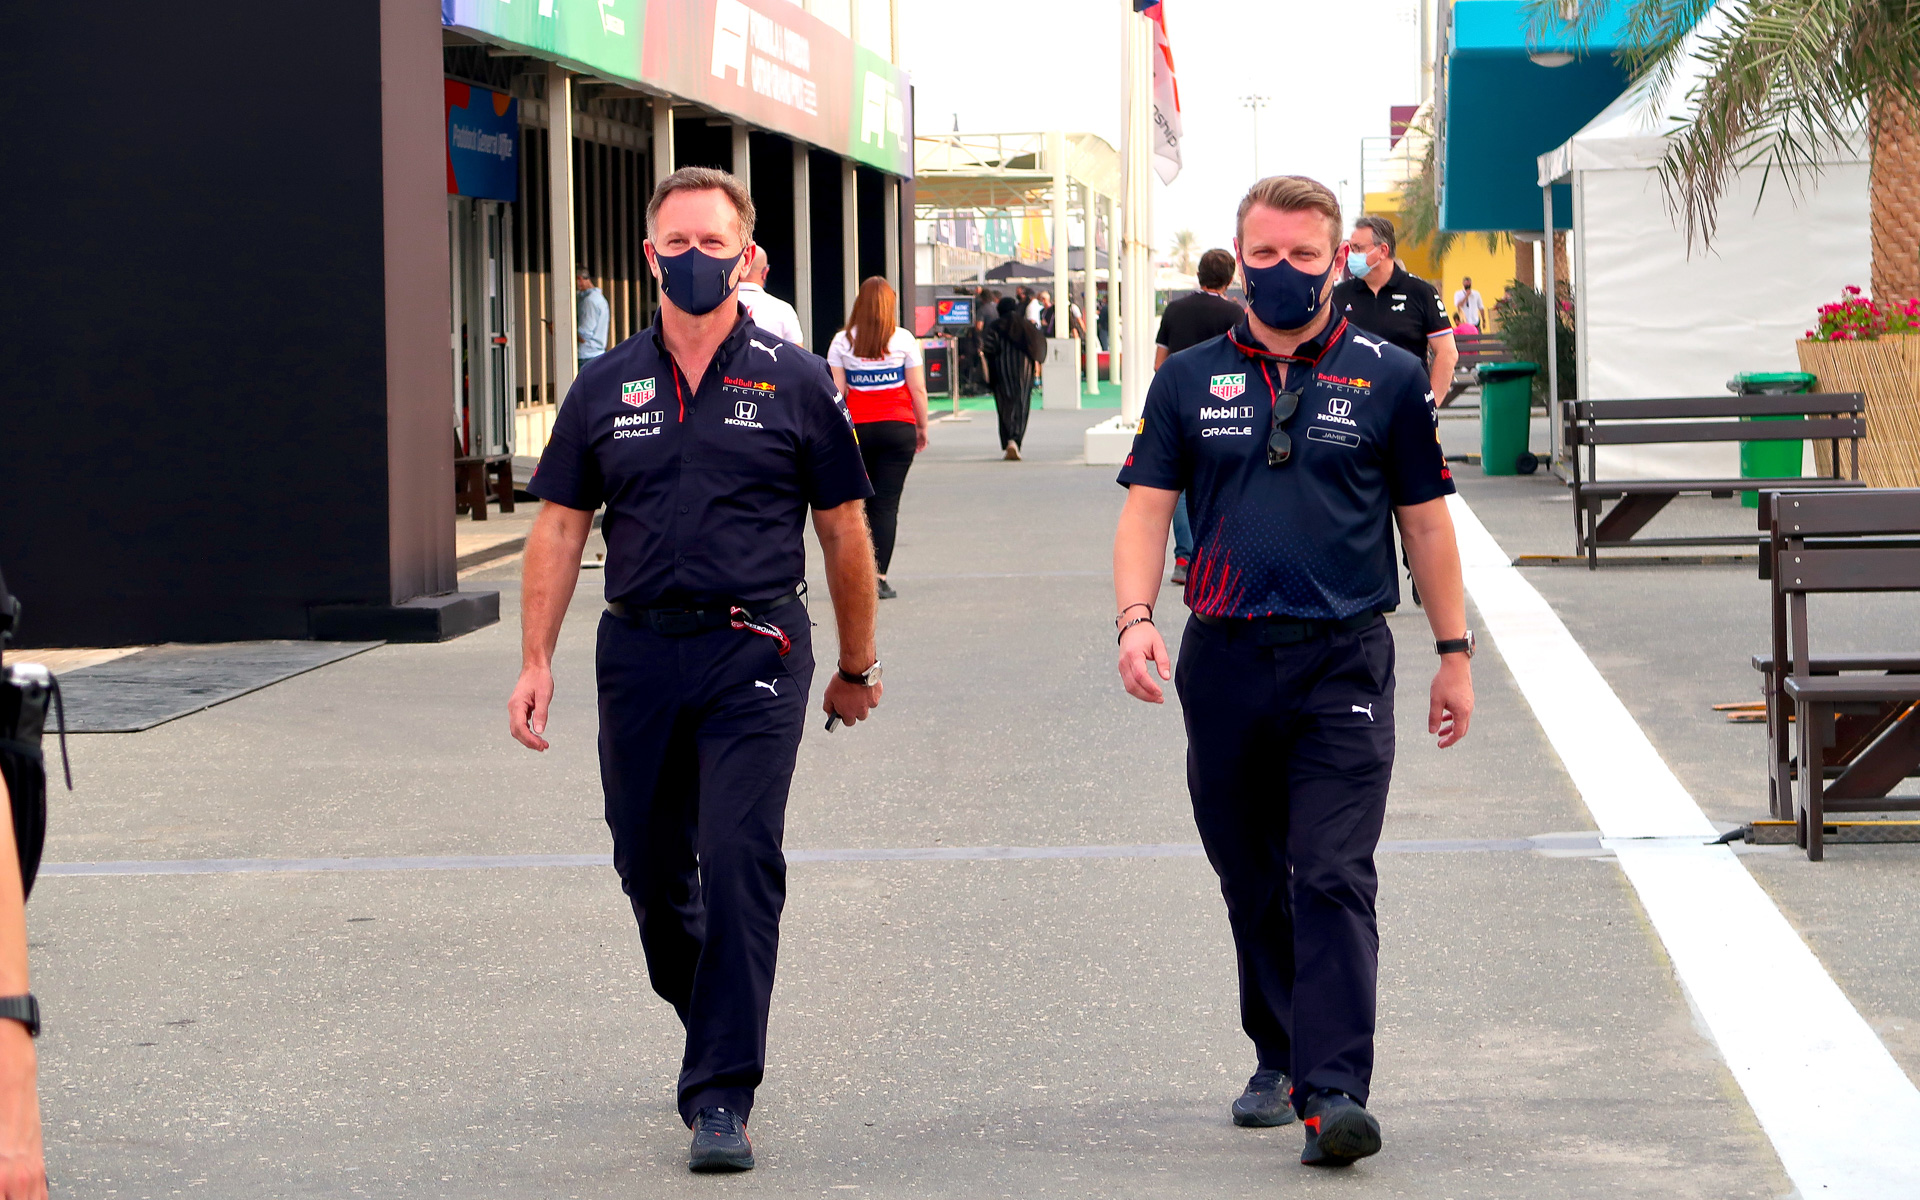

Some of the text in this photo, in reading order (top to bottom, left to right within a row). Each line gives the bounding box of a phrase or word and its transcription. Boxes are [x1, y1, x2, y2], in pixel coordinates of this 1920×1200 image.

[723, 376, 753, 388] Red Bull
[851, 371, 898, 383] URALKALI
[1213, 376, 1243, 385] TAG
[1317, 373, 1348, 384] Red Bull
[625, 379, 653, 393] TAG
[722, 386, 775, 399] RACING
[1212, 385, 1244, 398] HEUER
[1316, 381, 1370, 396] RACING
[624, 390, 654, 405] HEUER
[1200, 406, 1238, 420] Mobil
[613, 412, 650, 428] Mobil
[724, 417, 764, 429] HONDA
[1317, 413, 1357, 427] HONDA
[613, 426, 661, 440] ORACLE
[1201, 426, 1252, 438] ORACLE
[1322, 432, 1346, 442] JAMIE
